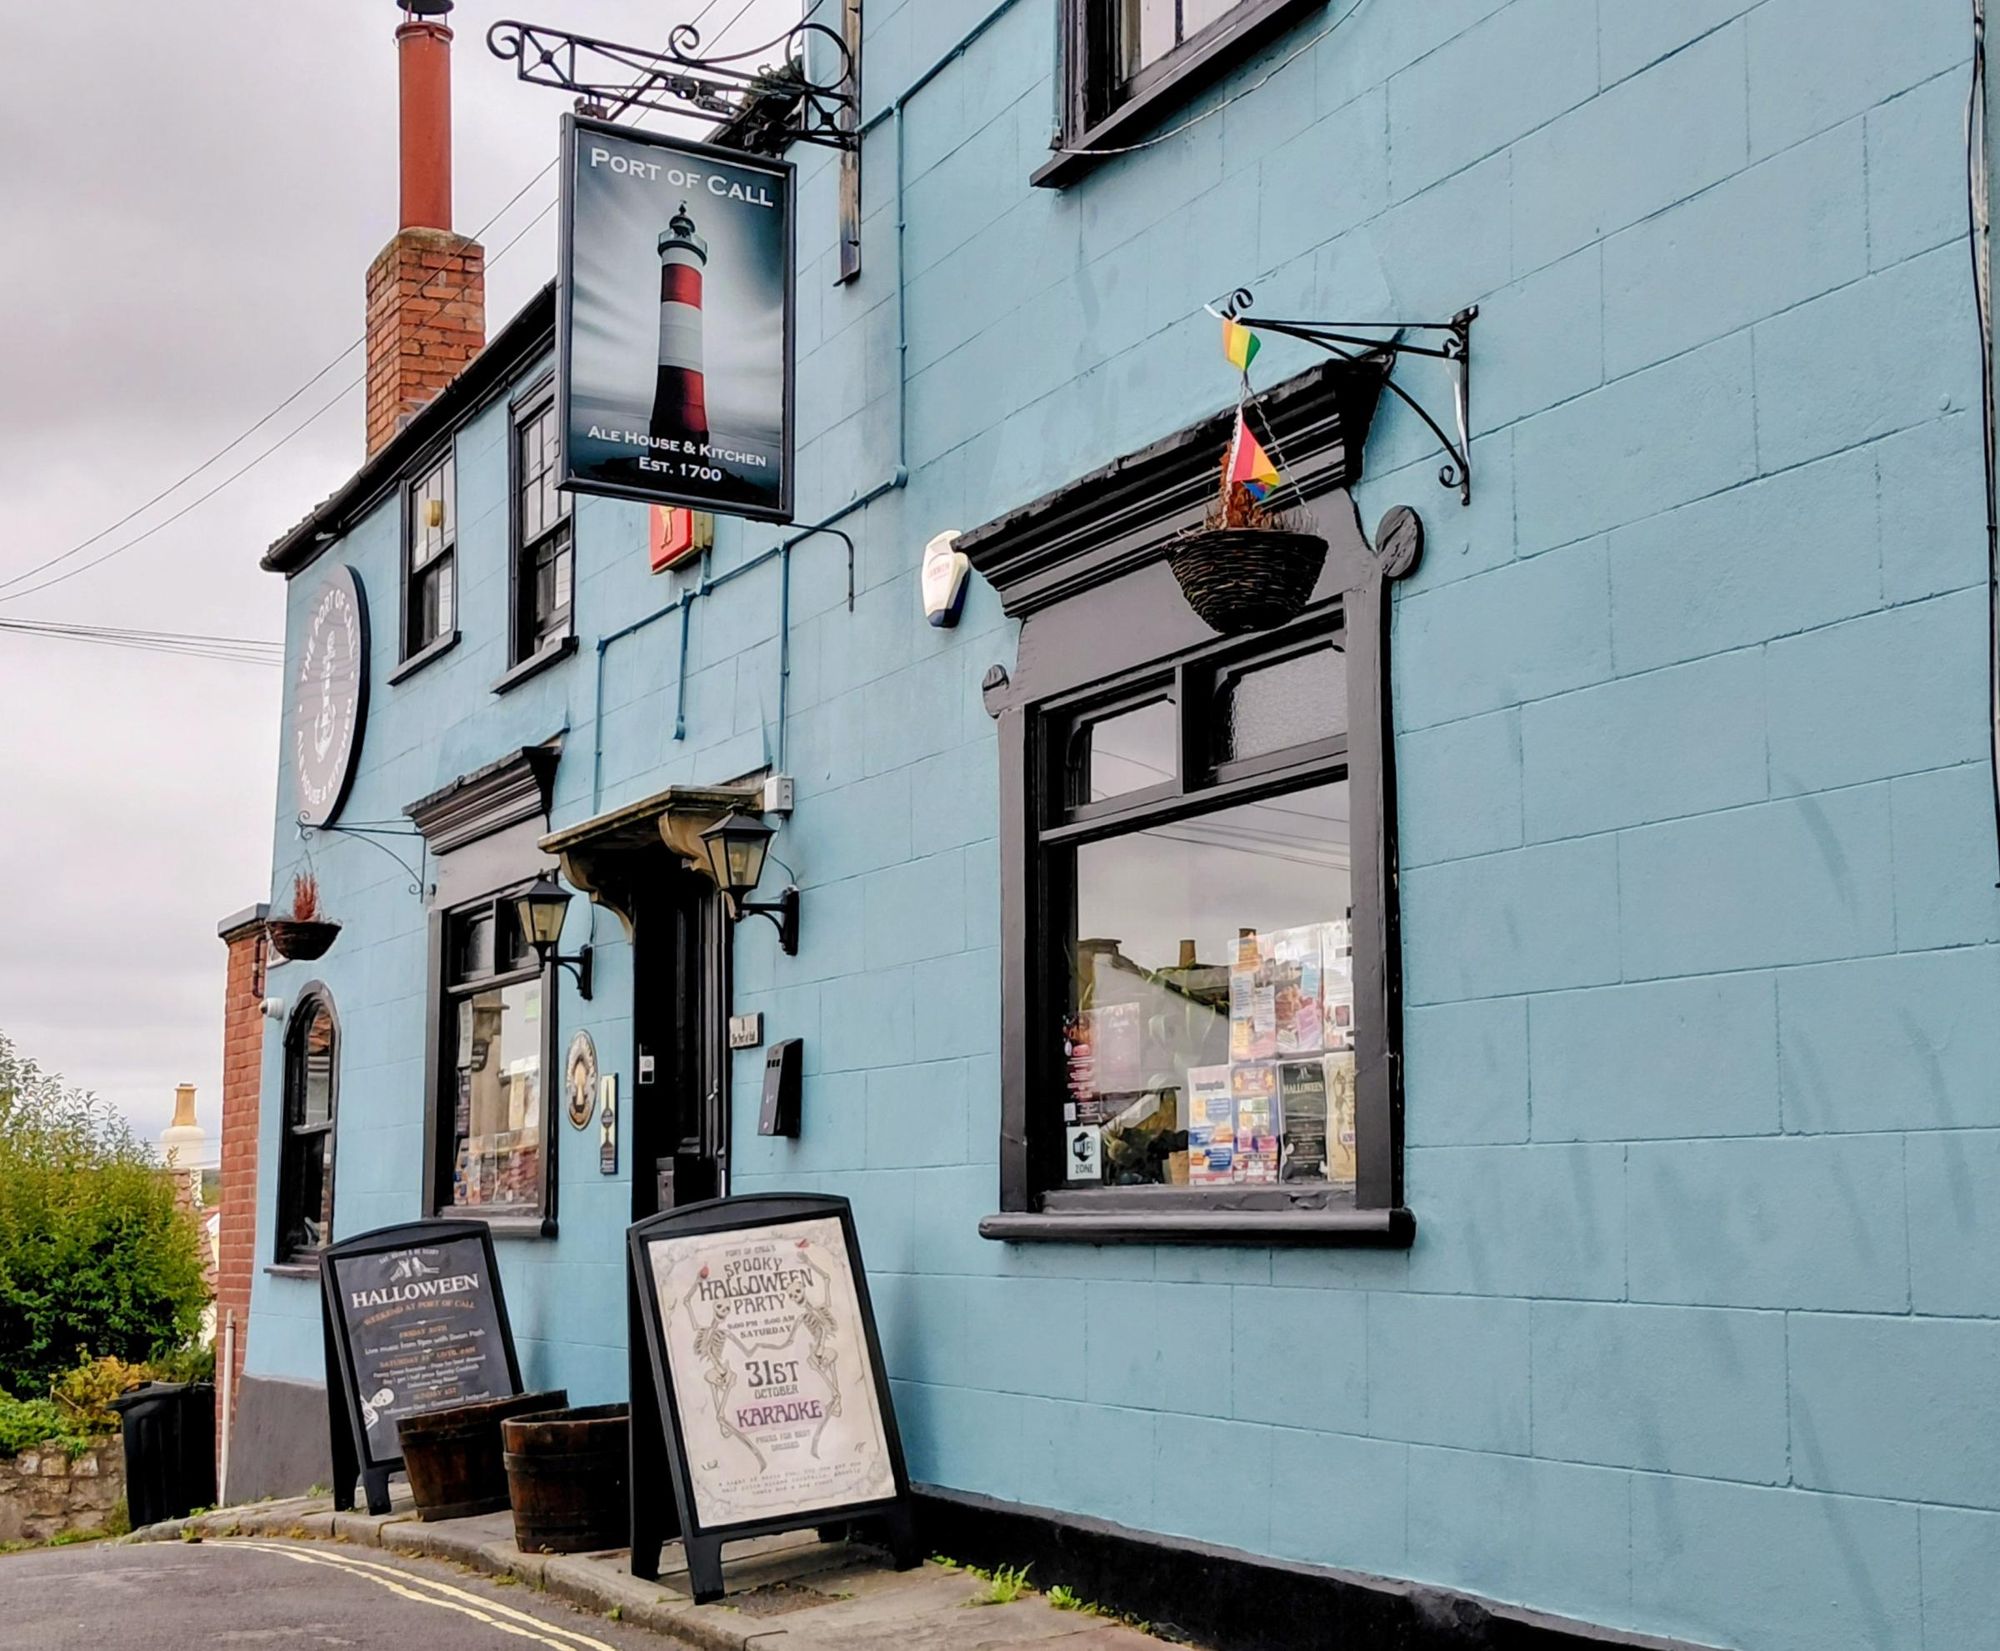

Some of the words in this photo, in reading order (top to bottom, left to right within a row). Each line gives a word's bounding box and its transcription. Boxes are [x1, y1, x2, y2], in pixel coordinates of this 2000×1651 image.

[590, 147, 661, 181] PORT
[667, 169, 700, 188] OF
[707, 175, 774, 207] CALL
[587, 425, 621, 442] ALE
[624, 429, 681, 452] HOUSE
[683, 440, 696, 455] &
[700, 443, 767, 467] KITCHEN
[638, 456, 674, 475] EST.
[680, 463, 722, 482] 1700
[1282, 1081, 1324, 1094] HALLOWEEN
[724, 1257, 783, 1278] SPOOKY
[351, 1273, 479, 1309] HALLOWEEN
[698, 1268, 814, 1301] HALLOWEEN
[405, 1302, 416, 1311] AT
[417, 1299, 439, 1308] PORT
[440, 1299, 452, 1308] OF
[454, 1300, 476, 1309] CALL
[734, 1293, 786, 1315] PARTY
[740, 1324, 792, 1339] SATURDAY
[365, 1347, 379, 1356] Live
[380, 1344, 399, 1353] music
[400, 1341, 417, 1349] from
[380, 1356, 419, 1368] SATURDAY
[745, 1360, 800, 1388] 31ST
[754, 1384, 800, 1400] OCTOBER
[736, 1399, 823, 1428] KARAOKE
